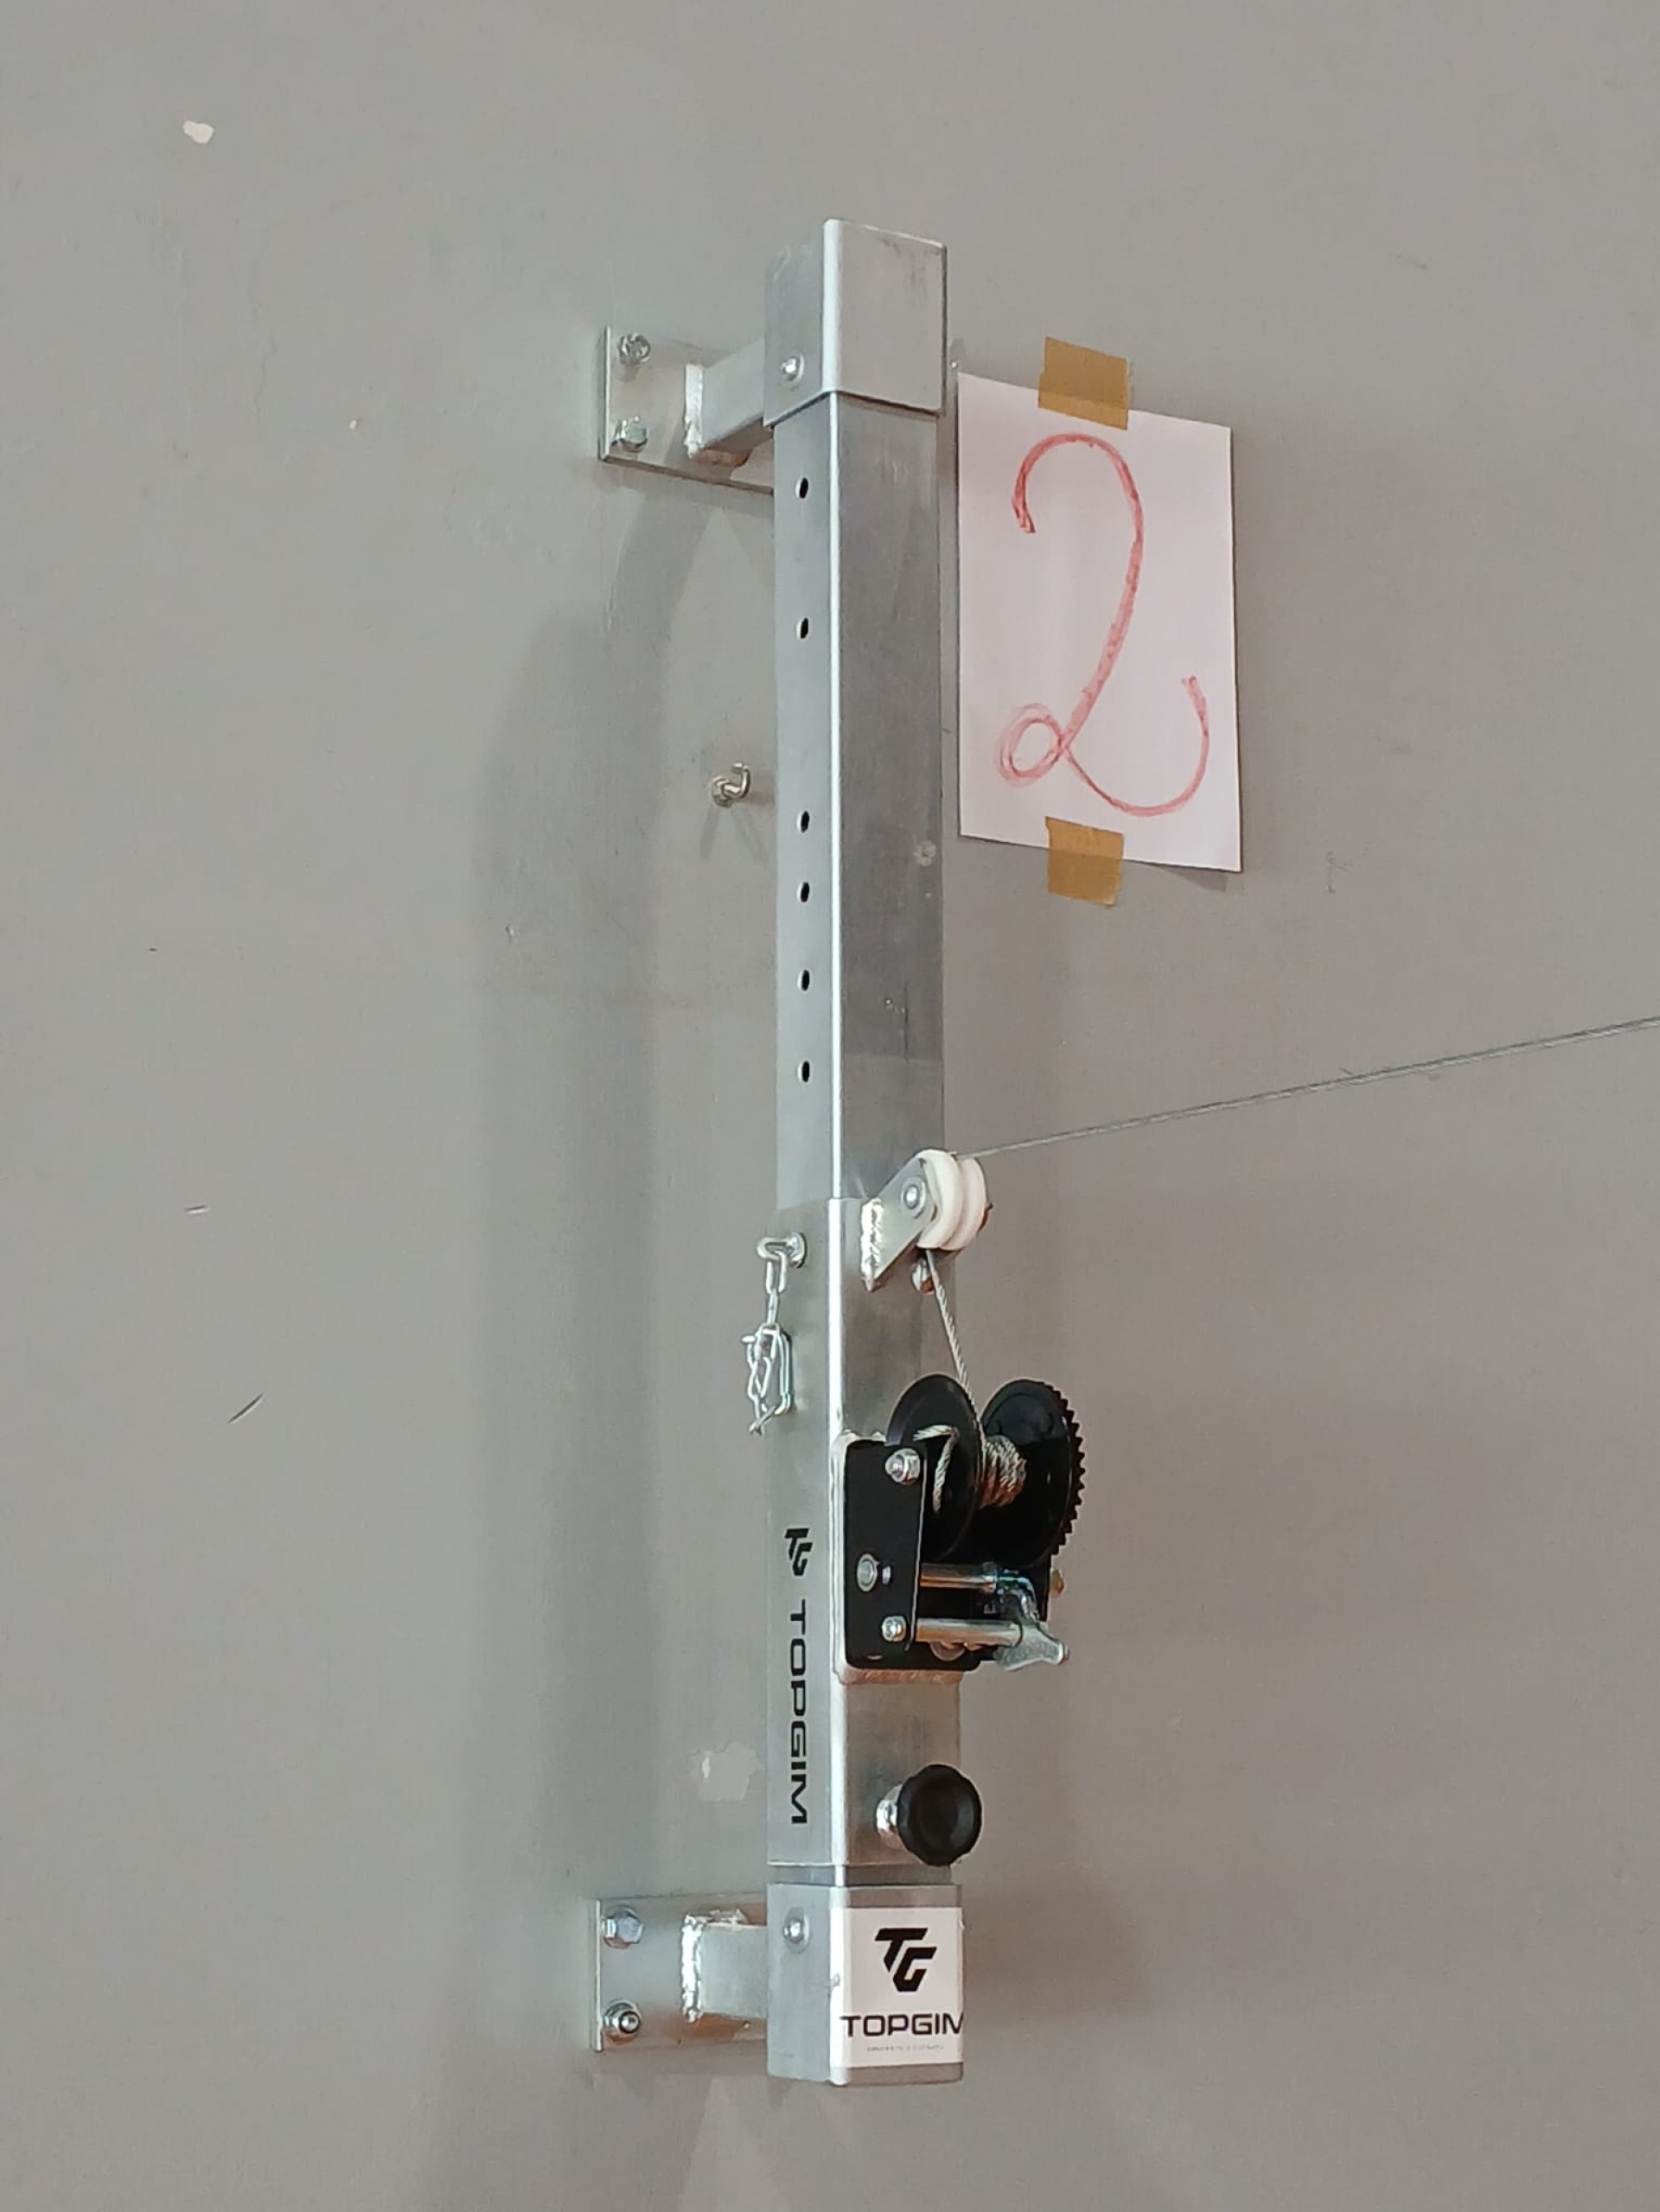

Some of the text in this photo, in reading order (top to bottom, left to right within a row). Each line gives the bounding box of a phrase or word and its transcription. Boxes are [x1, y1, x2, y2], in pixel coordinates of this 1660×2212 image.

[997, 433, 1209, 816] 2
[790, 1599, 808, 1824] TOPGIM
[875, 1928, 937, 1992] TG
